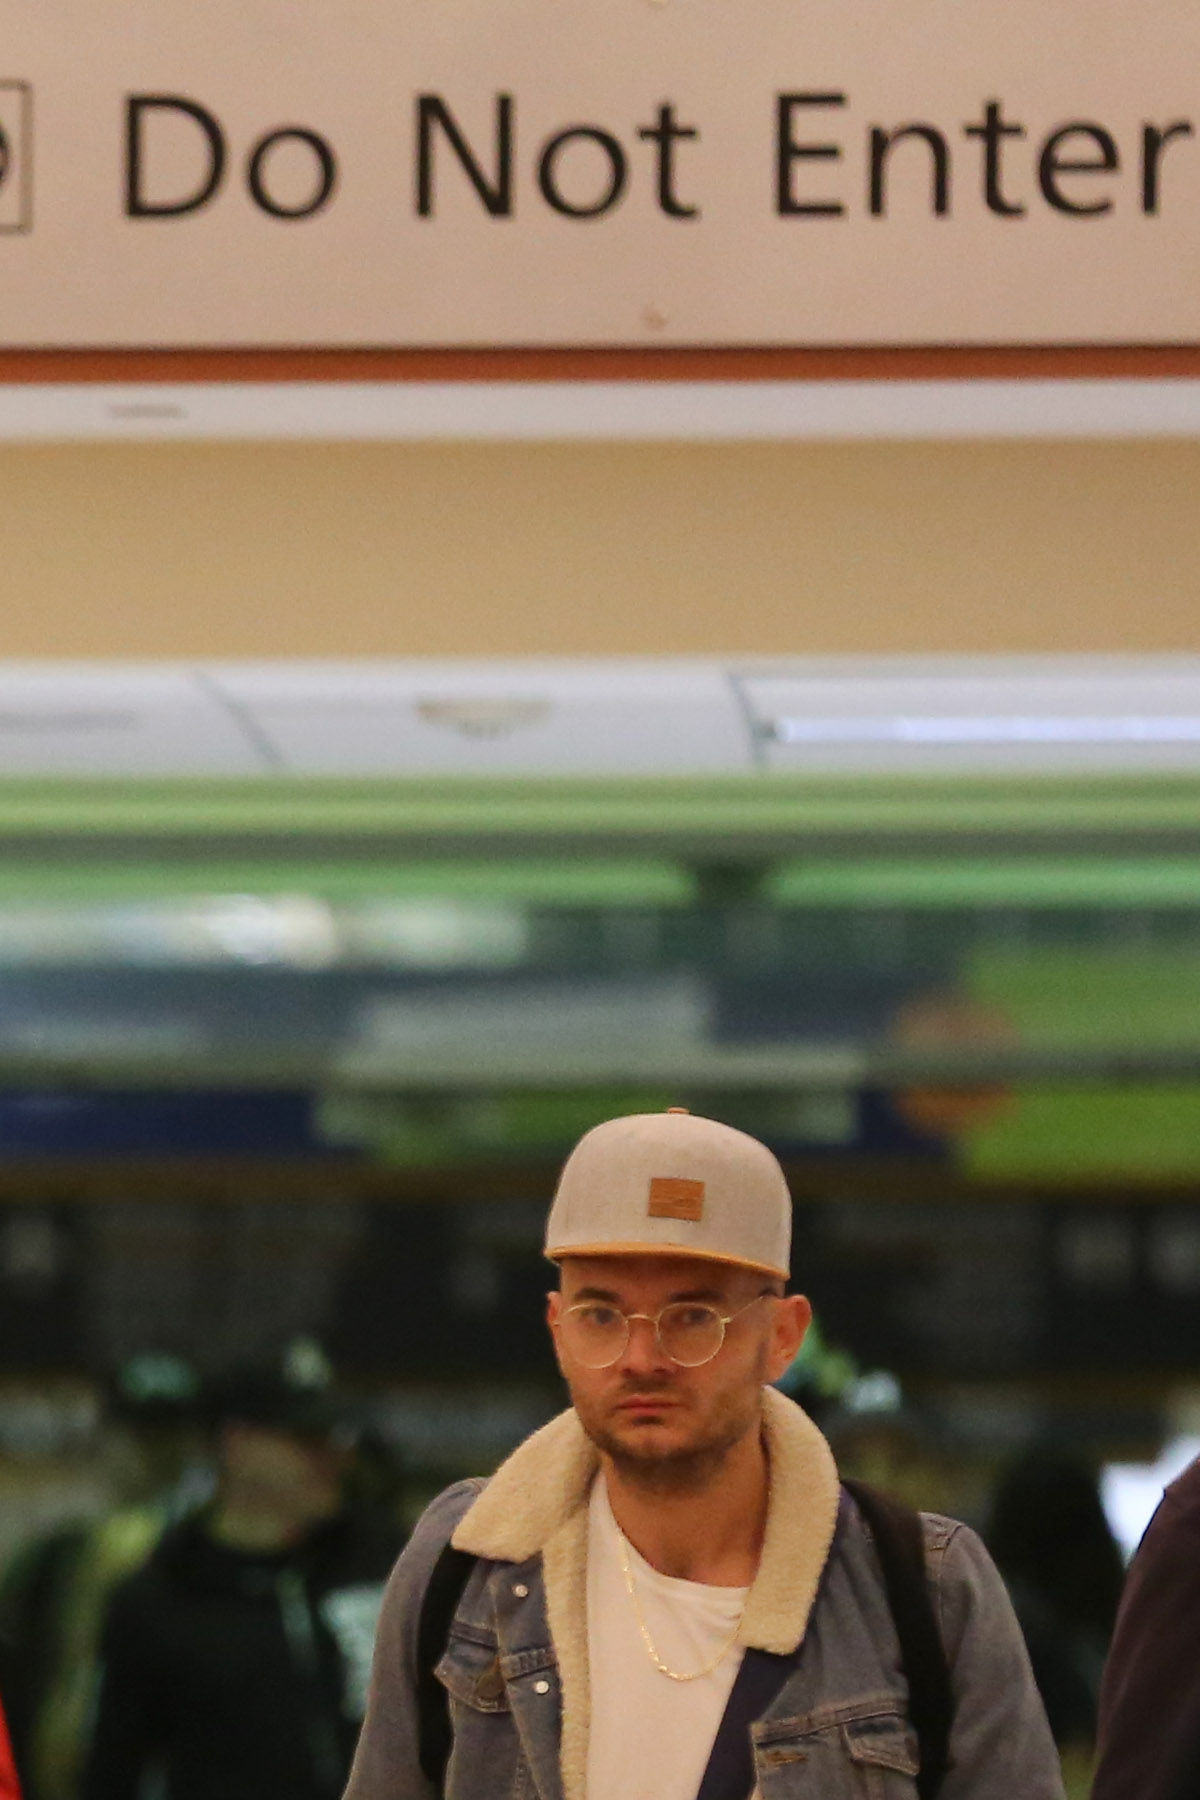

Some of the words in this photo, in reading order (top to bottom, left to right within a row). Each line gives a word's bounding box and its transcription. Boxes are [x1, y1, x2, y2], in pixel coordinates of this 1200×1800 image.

[122, 92, 339, 222] Do
[414, 92, 700, 222] Not
[774, 90, 1195, 222] Enter
